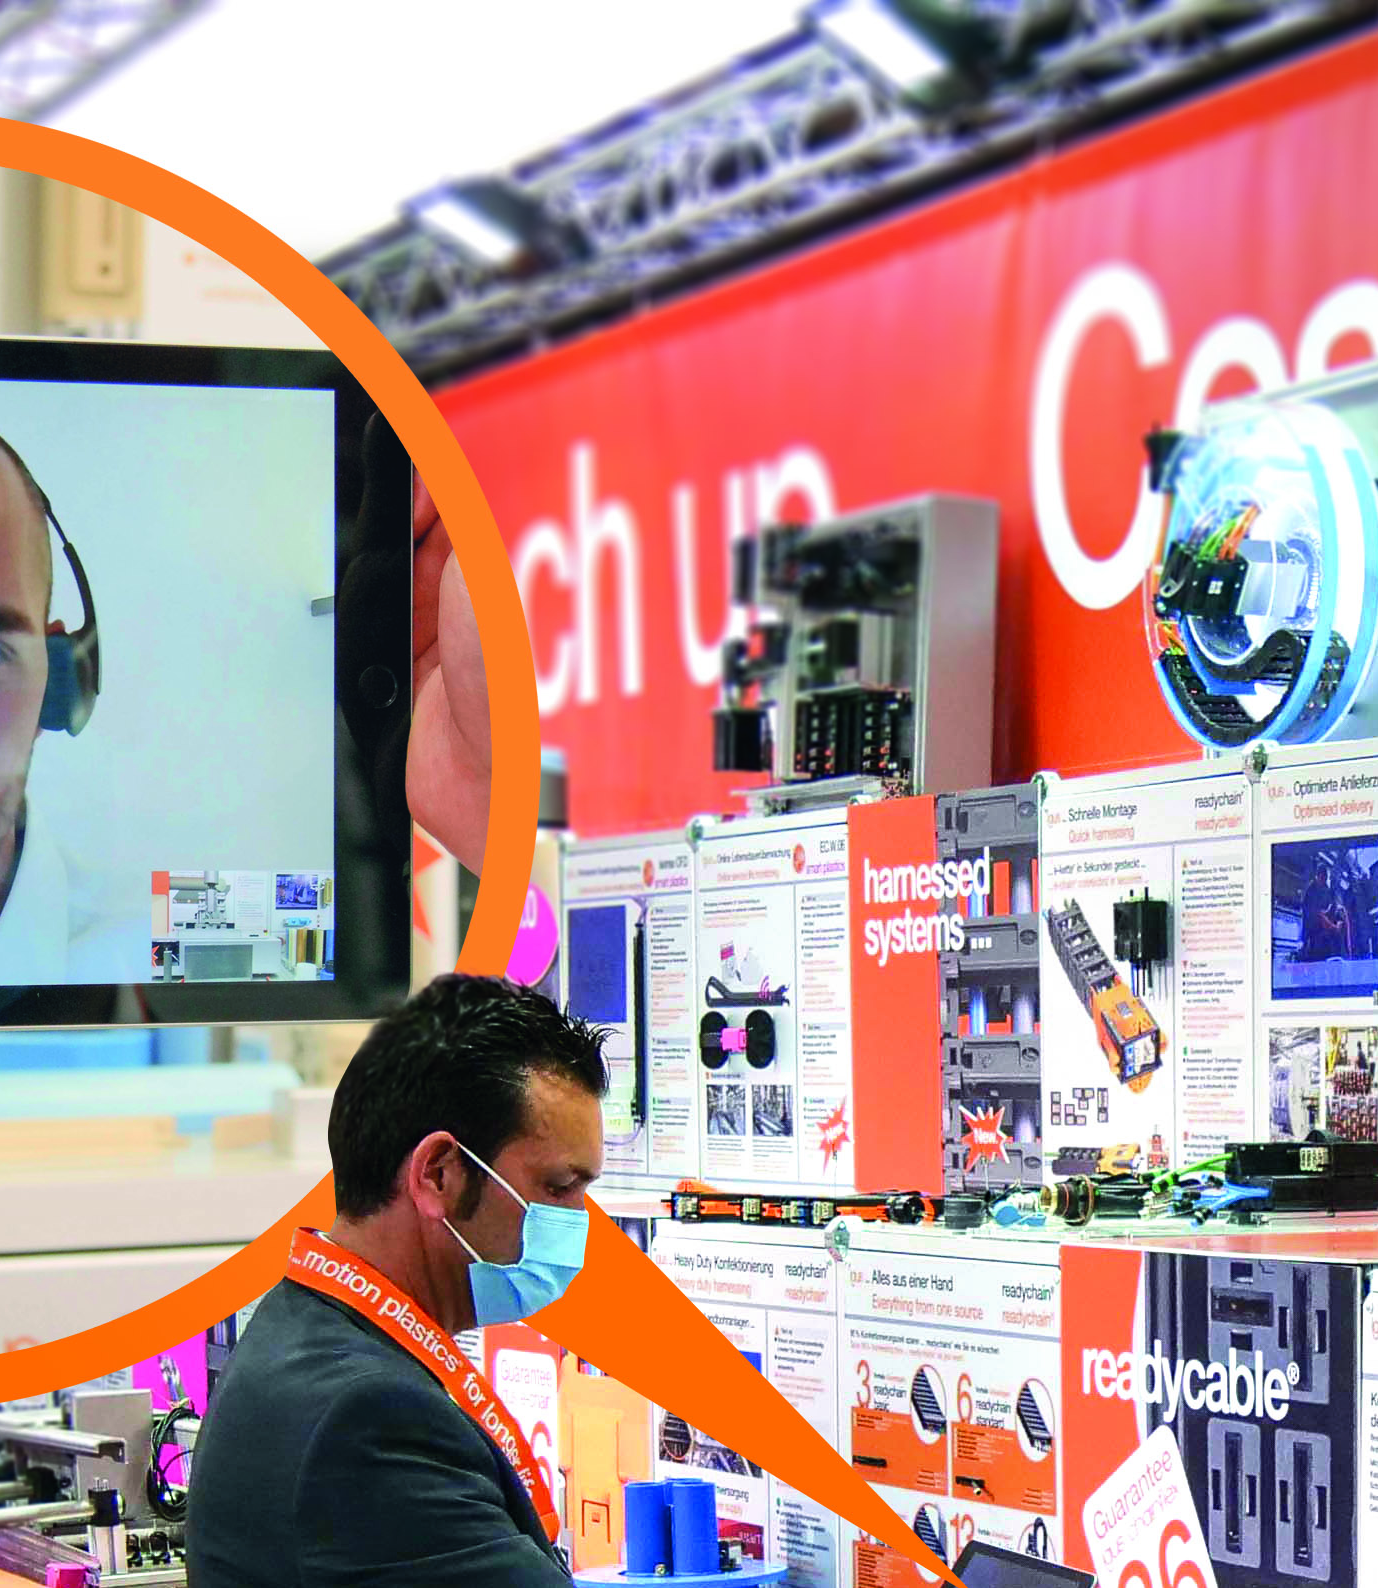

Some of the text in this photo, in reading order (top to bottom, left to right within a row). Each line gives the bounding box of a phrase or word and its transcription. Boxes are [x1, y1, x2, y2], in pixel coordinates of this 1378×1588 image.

[1293, 778, 1338, 799] Optimierte
[1103, 804, 1138, 819] Montage
[1294, 802, 1338, 822] Optimised
[1340, 800, 1373, 816] delivery
[1069, 828, 1091, 843] Quick
[864, 846, 991, 906] harnessed
[864, 912, 965, 967] systems
[303, 1249, 381, 1305] motion
[674, 1253, 773, 1277] Heavy Duty Konfektionierung
[872, 1269, 953, 1292] Alles aus einer Hand
[872, 1294, 983, 1320] Everything from one source
[1082, 1338, 1300, 1423] readycable®
[1093, 1450, 1173, 1539] Guarantee
